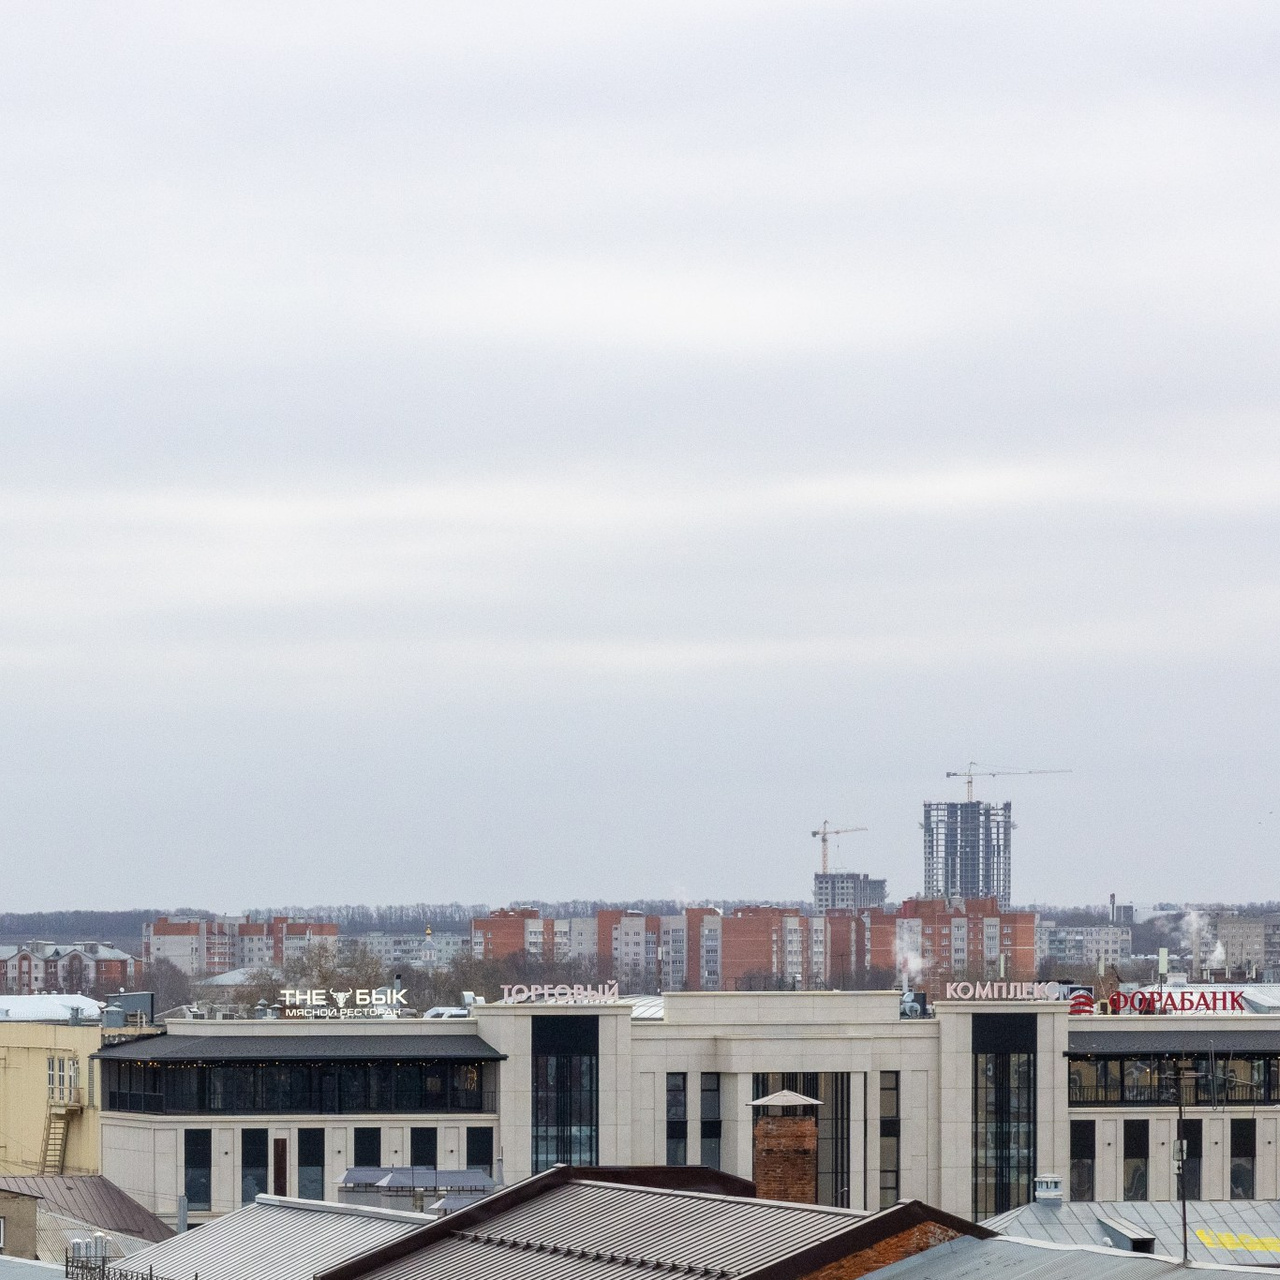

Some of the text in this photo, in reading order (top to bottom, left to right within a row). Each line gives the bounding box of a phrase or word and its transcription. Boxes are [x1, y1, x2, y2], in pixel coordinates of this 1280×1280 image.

[356, 989, 408, 1005] БЫК
[500, 980, 619, 1003] ТОРГОВЫЙ
[946, 981, 1060, 1000] КОМПЛЕКС
[1109, 991, 1245, 1011] ФОРАБАНК
[285, 1007, 401, 1017] МЯСНОЙ РЕСТОРАН
